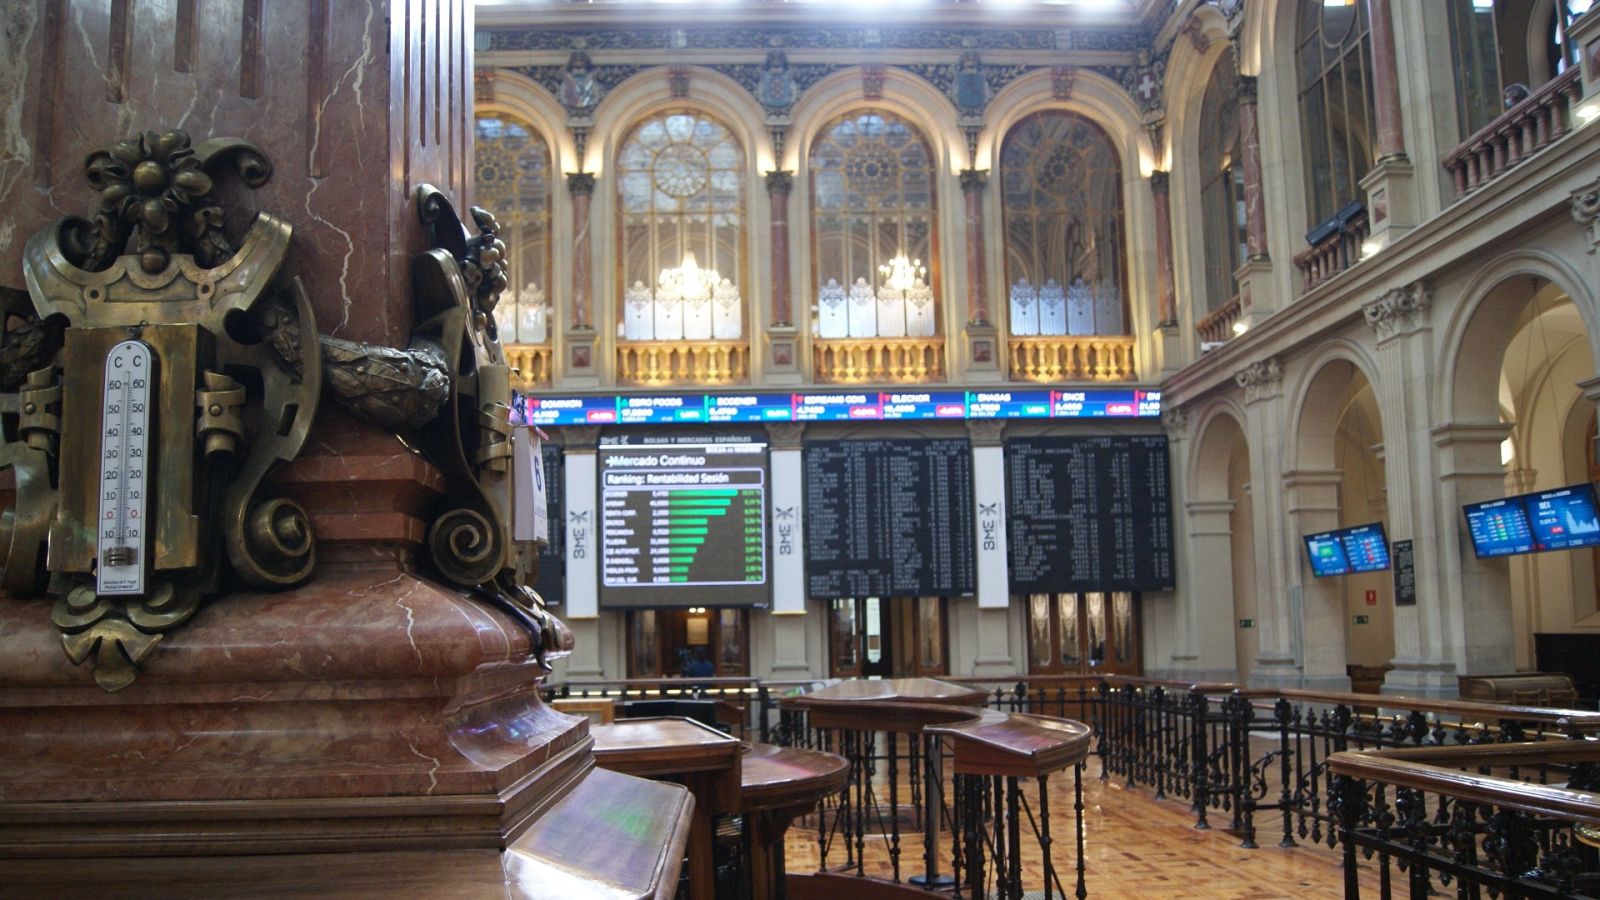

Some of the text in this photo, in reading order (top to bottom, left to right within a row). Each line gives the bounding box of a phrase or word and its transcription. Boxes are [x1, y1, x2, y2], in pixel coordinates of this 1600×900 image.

[114, 356, 142, 368] C C
[109, 379, 145, 389] 60 60
[109, 404, 144, 413] 50 50
[107, 427, 142, 436] 40 40
[106, 448, 142, 458] 30 30
[613, 455, 705, 467] Mercado Continuo
[106, 470, 141, 480] 20 20
[535, 456, 541, 492] 6
[607, 473, 729, 485] Ranking: Rentabilidad Sesión
[106, 491, 140, 500] 10 10
[779, 524, 791, 555] BME
[983, 520, 995, 550] BME
[573, 528, 585, 559] BME
